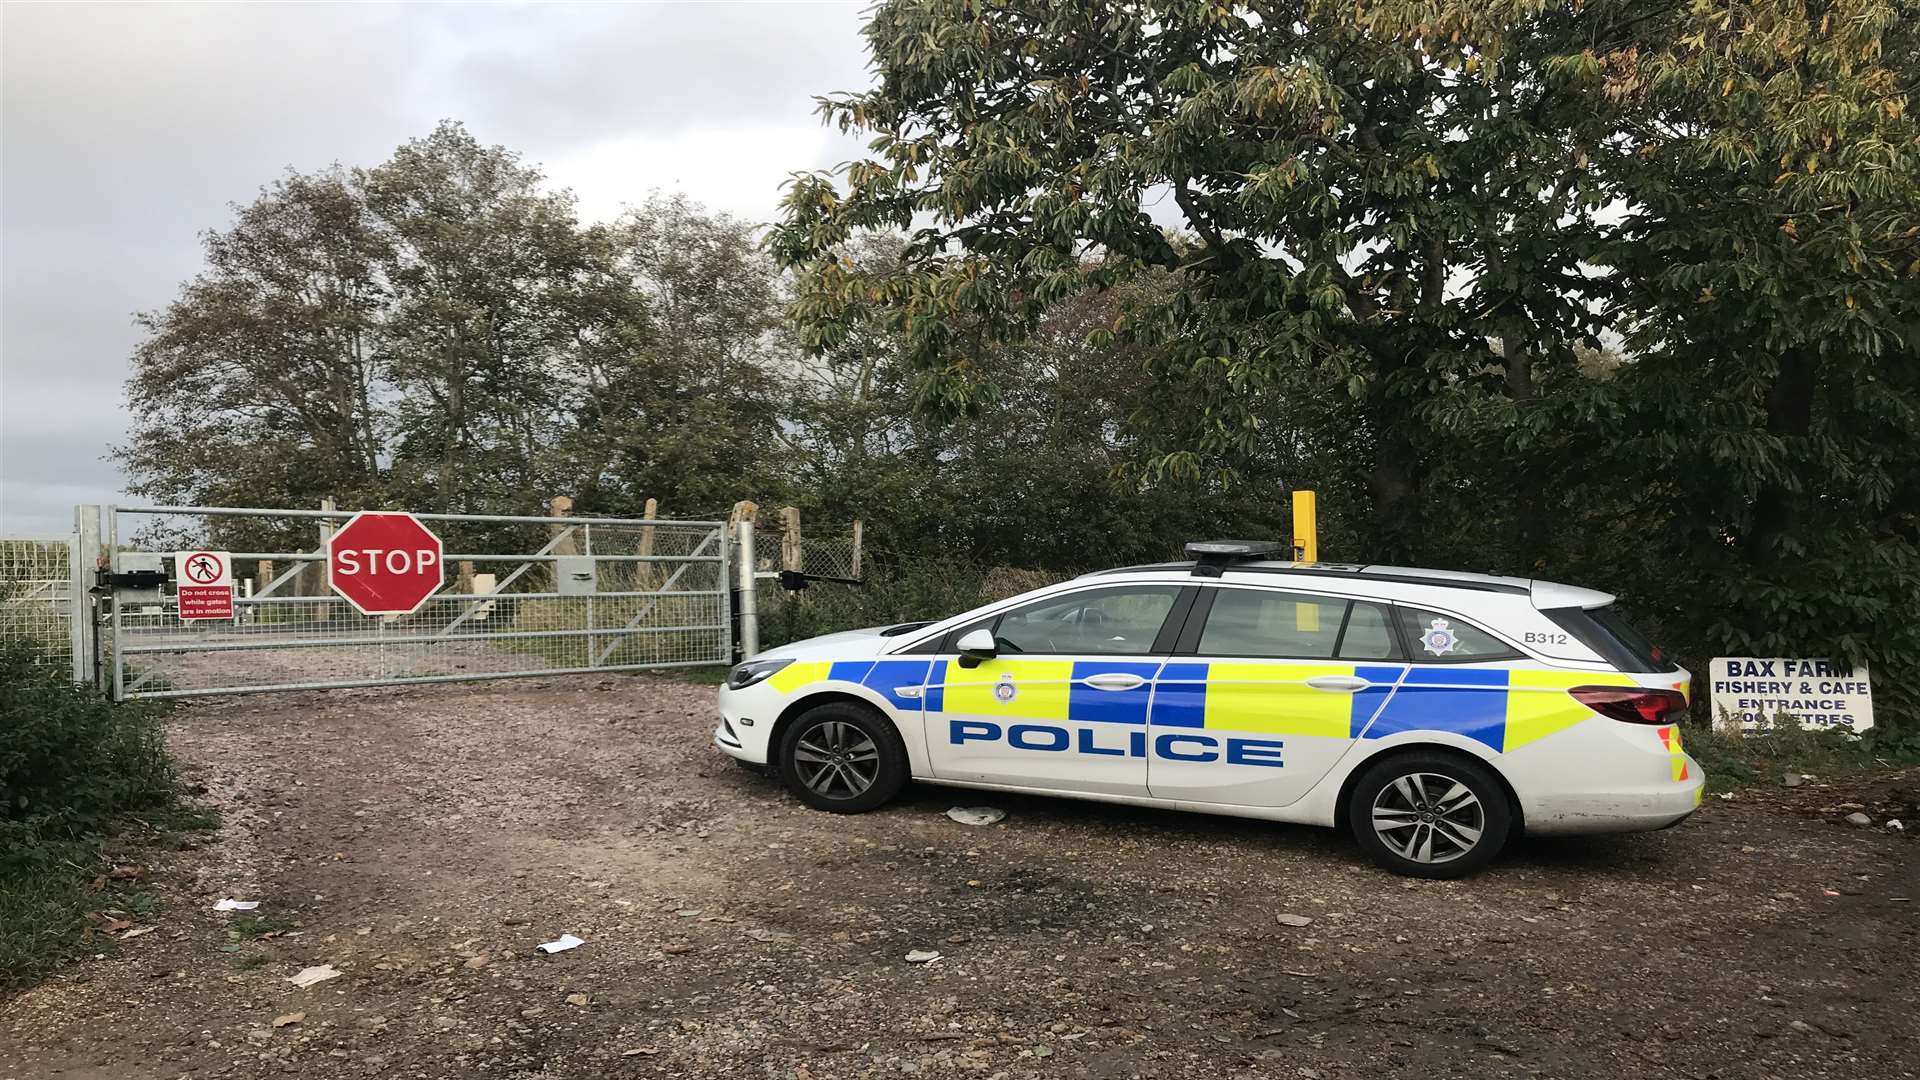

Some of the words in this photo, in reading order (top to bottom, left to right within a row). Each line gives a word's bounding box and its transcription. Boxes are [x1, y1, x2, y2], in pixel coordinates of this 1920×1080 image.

[337, 549, 436, 575] STOP
[1524, 632, 1567, 645] B312
[1727, 661, 1776, 678] BAX
[1715, 681, 1793, 694] FISHERY
[1799, 682, 1812, 695] &
[1819, 682, 1868, 695] CAFE
[1738, 699, 1847, 710] ENTRANCE
[949, 719, 1284, 768] POLICE
